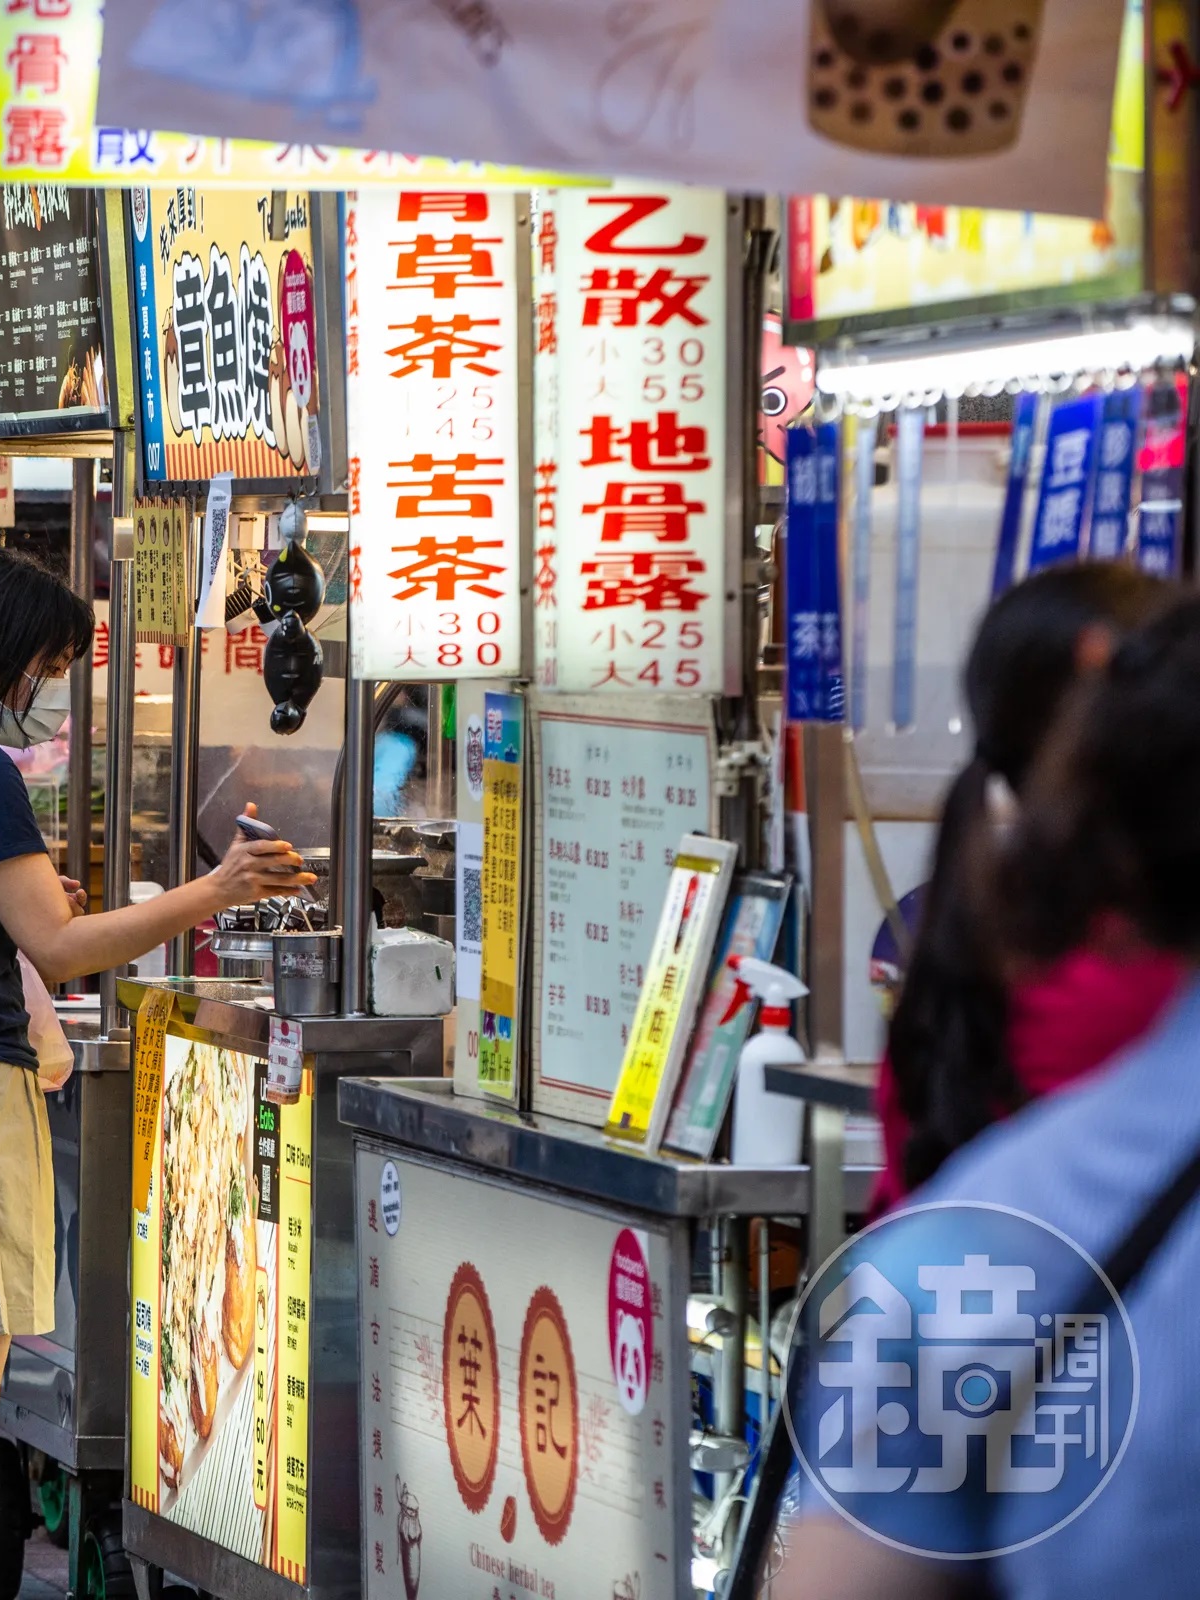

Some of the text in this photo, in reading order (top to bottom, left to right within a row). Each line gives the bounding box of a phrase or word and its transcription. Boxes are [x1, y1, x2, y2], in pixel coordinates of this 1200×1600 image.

[139, 263, 153, 422] 寧夏夜市
[174, 255, 277, 440] 章魚燒
[147, 443, 161, 473] 007
[386, 453, 506, 600] 苦茶
[578, 411, 712, 612] 地骨露
[259, 1104, 275, 1132] Eats
[286, 1143, 296, 1166] 口味
[136, 1300, 152, 1334] 起司燒
[286, 1453, 305, 1483] 蜂蜜芥末
[470, 1542, 506, 1579] Chinese
[509, 1558, 538, 1597] herbal
[540, 1577, 556, 1600] tea
